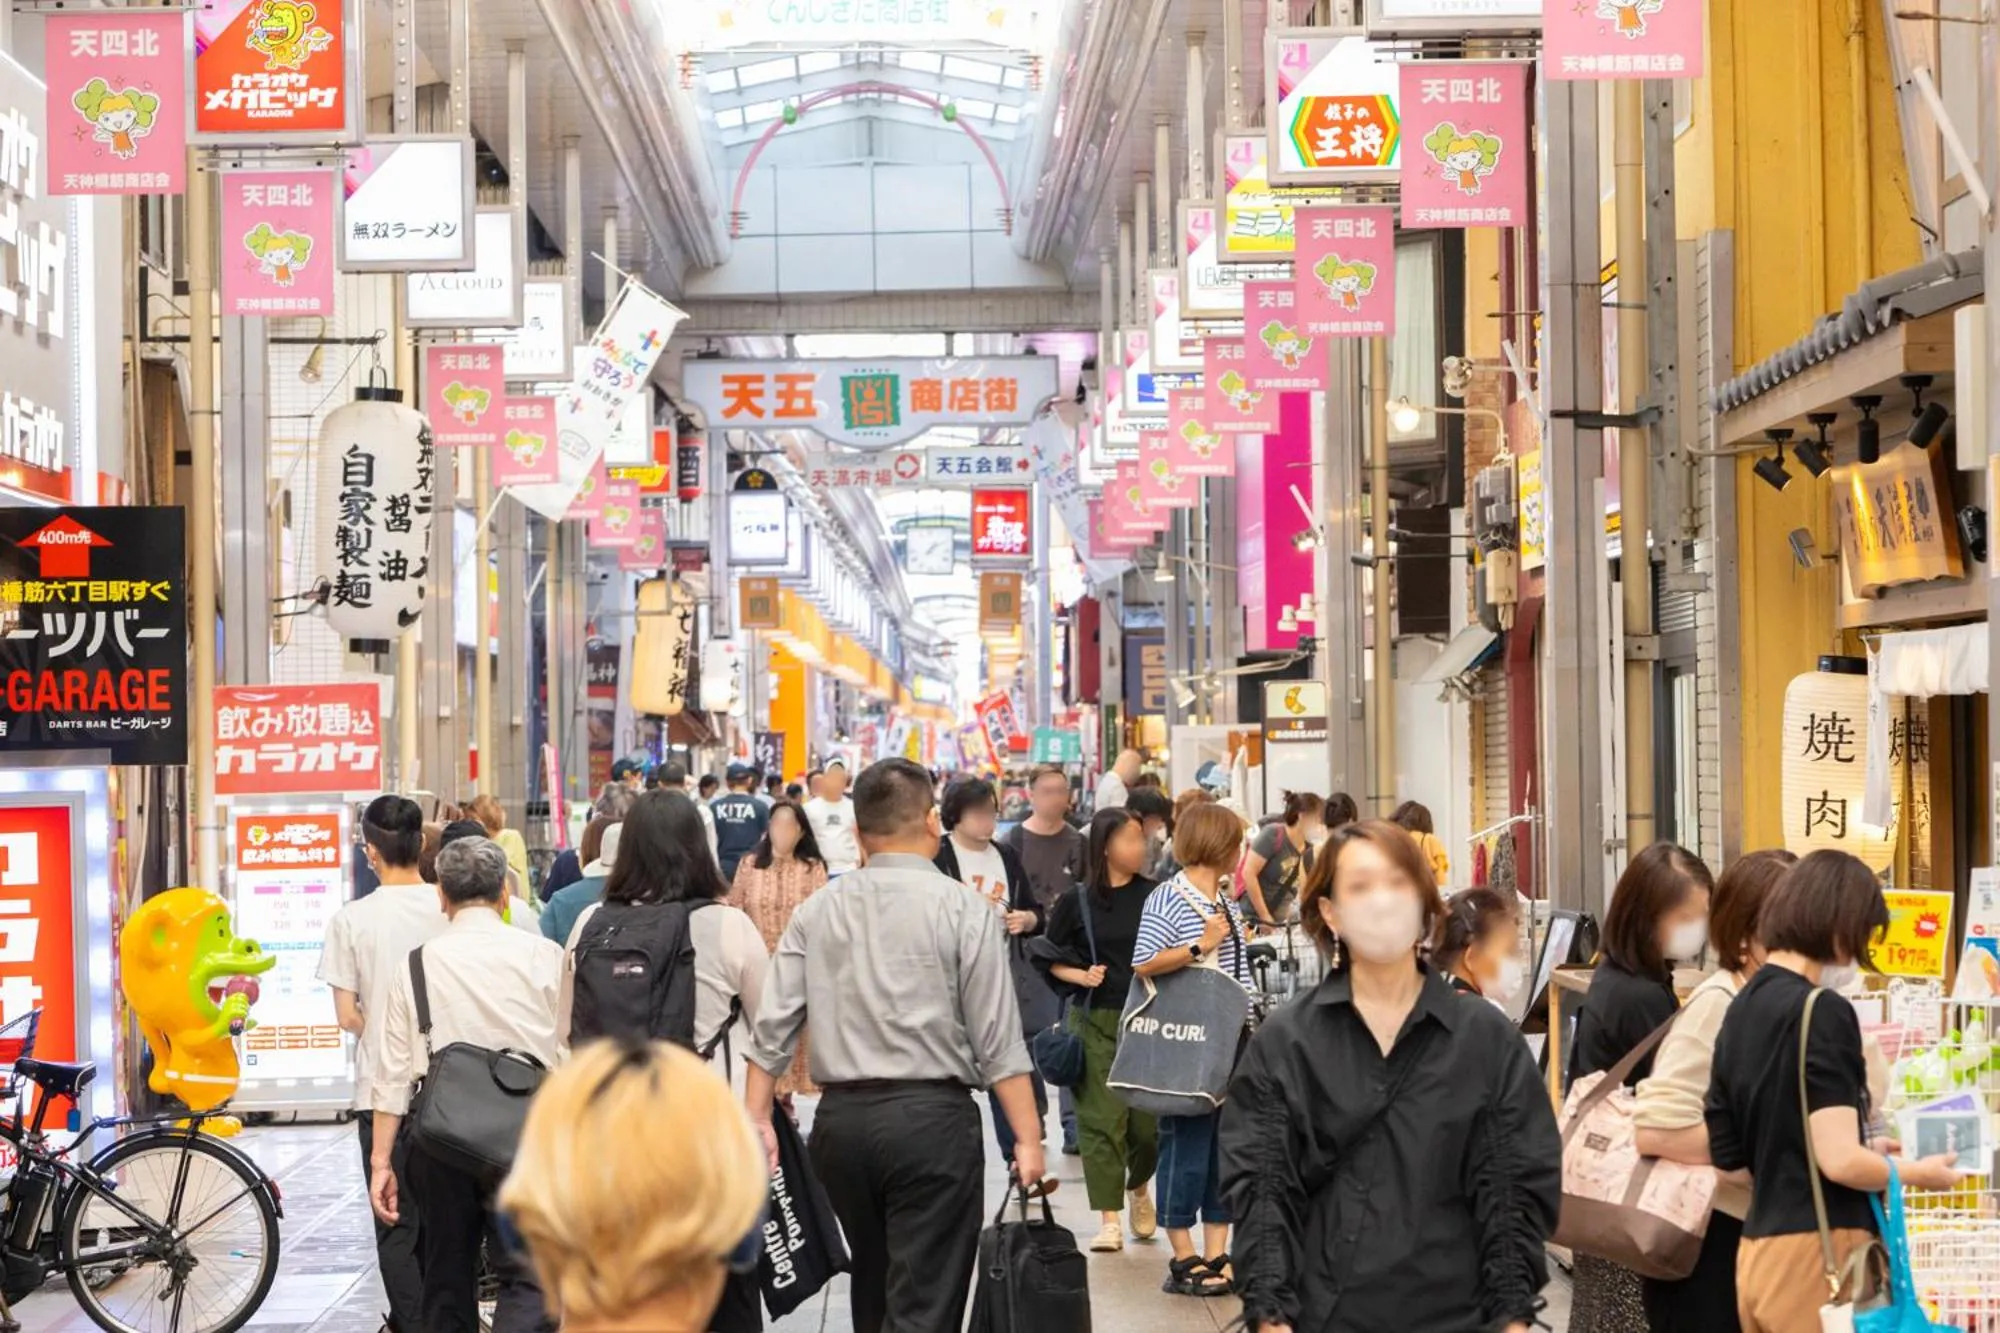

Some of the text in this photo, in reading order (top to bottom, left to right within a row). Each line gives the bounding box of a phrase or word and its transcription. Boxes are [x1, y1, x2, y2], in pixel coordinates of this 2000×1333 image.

[70, 29, 161, 58] 天四北
[1562, 54, 1686, 72] 天神橋筋商店会
[231, 72, 309, 88] カラオケ
[1420, 78, 1502, 104] 天四北
[204, 86, 337, 110] メガビッグ
[247, 109, 294, 118] KARAOKE
[1313, 123, 1384, 160] 王将
[63, 173, 171, 190] 天神橋筋商店会
[241, 184, 314, 207] 天四北
[1414, 207, 1513, 223] 天神橋筋商店会
[352, 222, 458, 241] 無双ラーメン
[1311, 218, 1377, 239] 天四北
[1258, 290, 1295, 308] 天四
[440, 353, 492, 370] 天四北
[721, 373, 1018, 419] 天五 商店街
[936, 456, 1014, 476] 天五会館
[811, 469, 893, 487] 天満市場
[37, 530, 92, 545] 400m先
[332, 443, 377, 611] 自家製麺
[377, 492, 413, 583] 醤油
[0, 580, 171, 603] 橋筋六丁目駅すぐ
[0, 668, 171, 713] GARAGE
[49, 717, 171, 730] DARTS BAR ビーガレージ
[215, 742, 379, 776] カラオケ
[1801, 711, 1856, 840] 焼肉
[716, 802, 756, 821] KITA
[1130, 1015, 1207, 1043] RIP CURL
[762, 1220, 797, 1289] Centre
